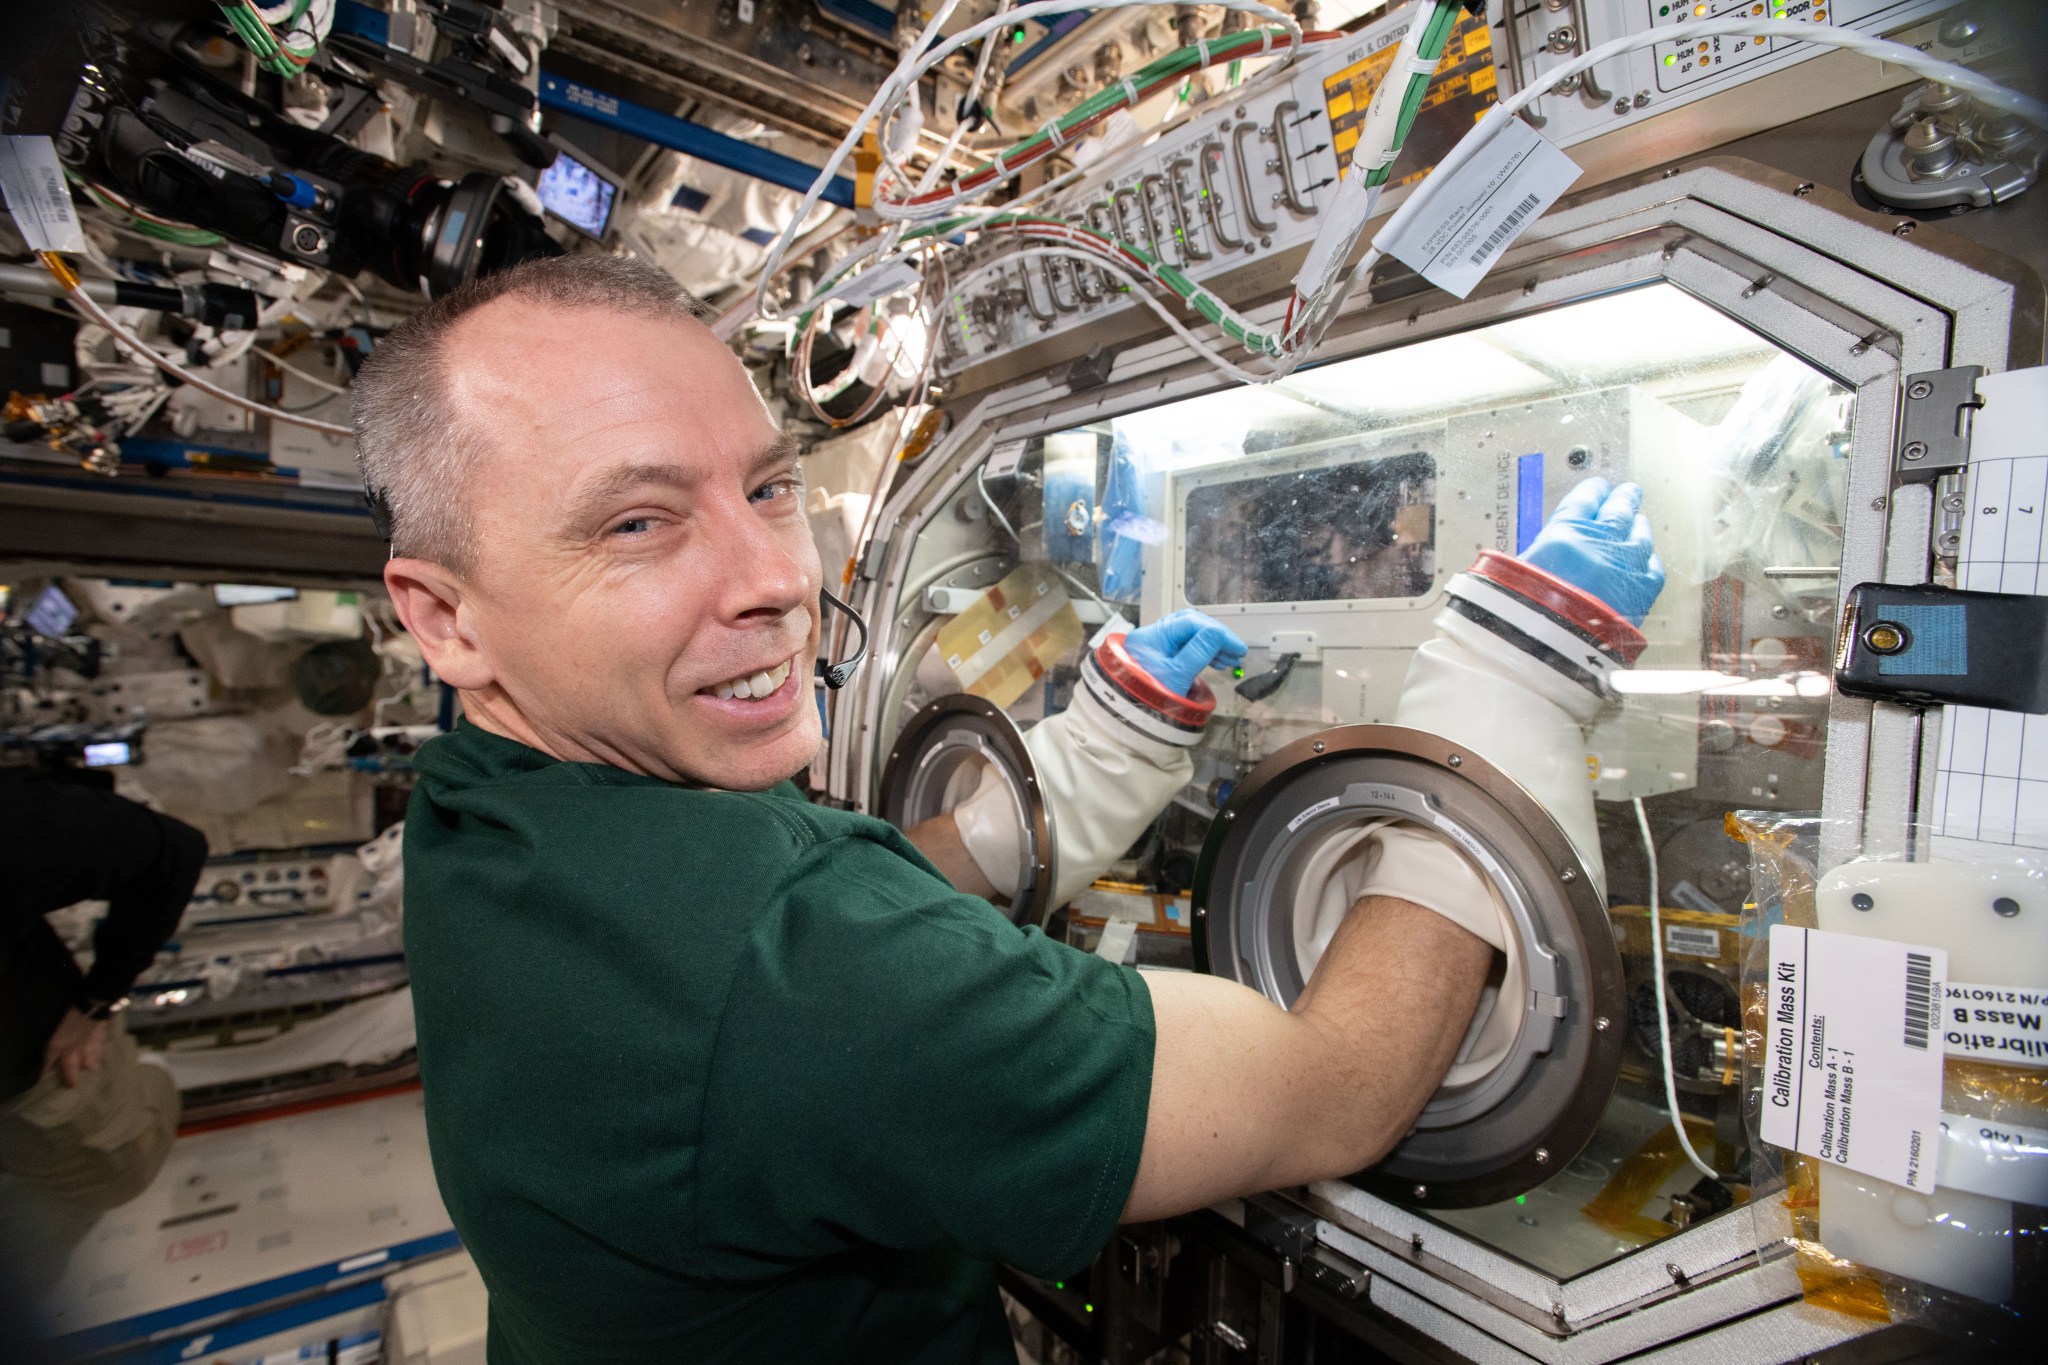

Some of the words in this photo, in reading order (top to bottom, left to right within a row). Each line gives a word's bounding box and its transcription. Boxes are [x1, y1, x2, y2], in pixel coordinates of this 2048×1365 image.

[1786, 0, 1811, 18] DOOR
[1347, 48, 1364, 63] INFO
[1366, 43, 1375, 54] &
[1480, 51, 1493, 64] F5
[1677, 47, 1695, 62] HUM
[1715, 55, 1722, 65] R
[1421, 220, 1450, 251] EXPRESS
[1448, 204, 1465, 221] Rack
[1427, 245, 1436, 255] 28
[1434, 231, 1449, 246] VDC
[1447, 212, 1467, 232] Power
[1464, 189, 1488, 214] Jumper
[1440, 251, 1453, 264] P/N
[1497, 452, 1510, 499] DEVICE
[1982, 507, 1998, 515] 8
[2018, 506, 2033, 514] 7
[1777, 962, 1796, 983] Kit
[1776, 987, 1795, 1024] Mass
[1930, 982, 1943, 1030] 00238159A
[1953, 1008, 1968, 1022] B
[1974, 1009, 2041, 1030] Mass
[1809, 1015, 1823, 1069] Contents:
[1771, 1027, 1794, 1108] Calibration
[1827, 1062, 1837, 1070] A
[1843, 1066, 1853, 1074] B
[1825, 1073, 1837, 1100] Mass
[1841, 1077, 1853, 1105] Mass
[1820, 1102, 1835, 1159] Calibration
[1836, 1107, 1851, 1164] Calibration
[1909, 1130, 1922, 1168] 2160201
[1907, 1169, 1918, 1187] P/N
